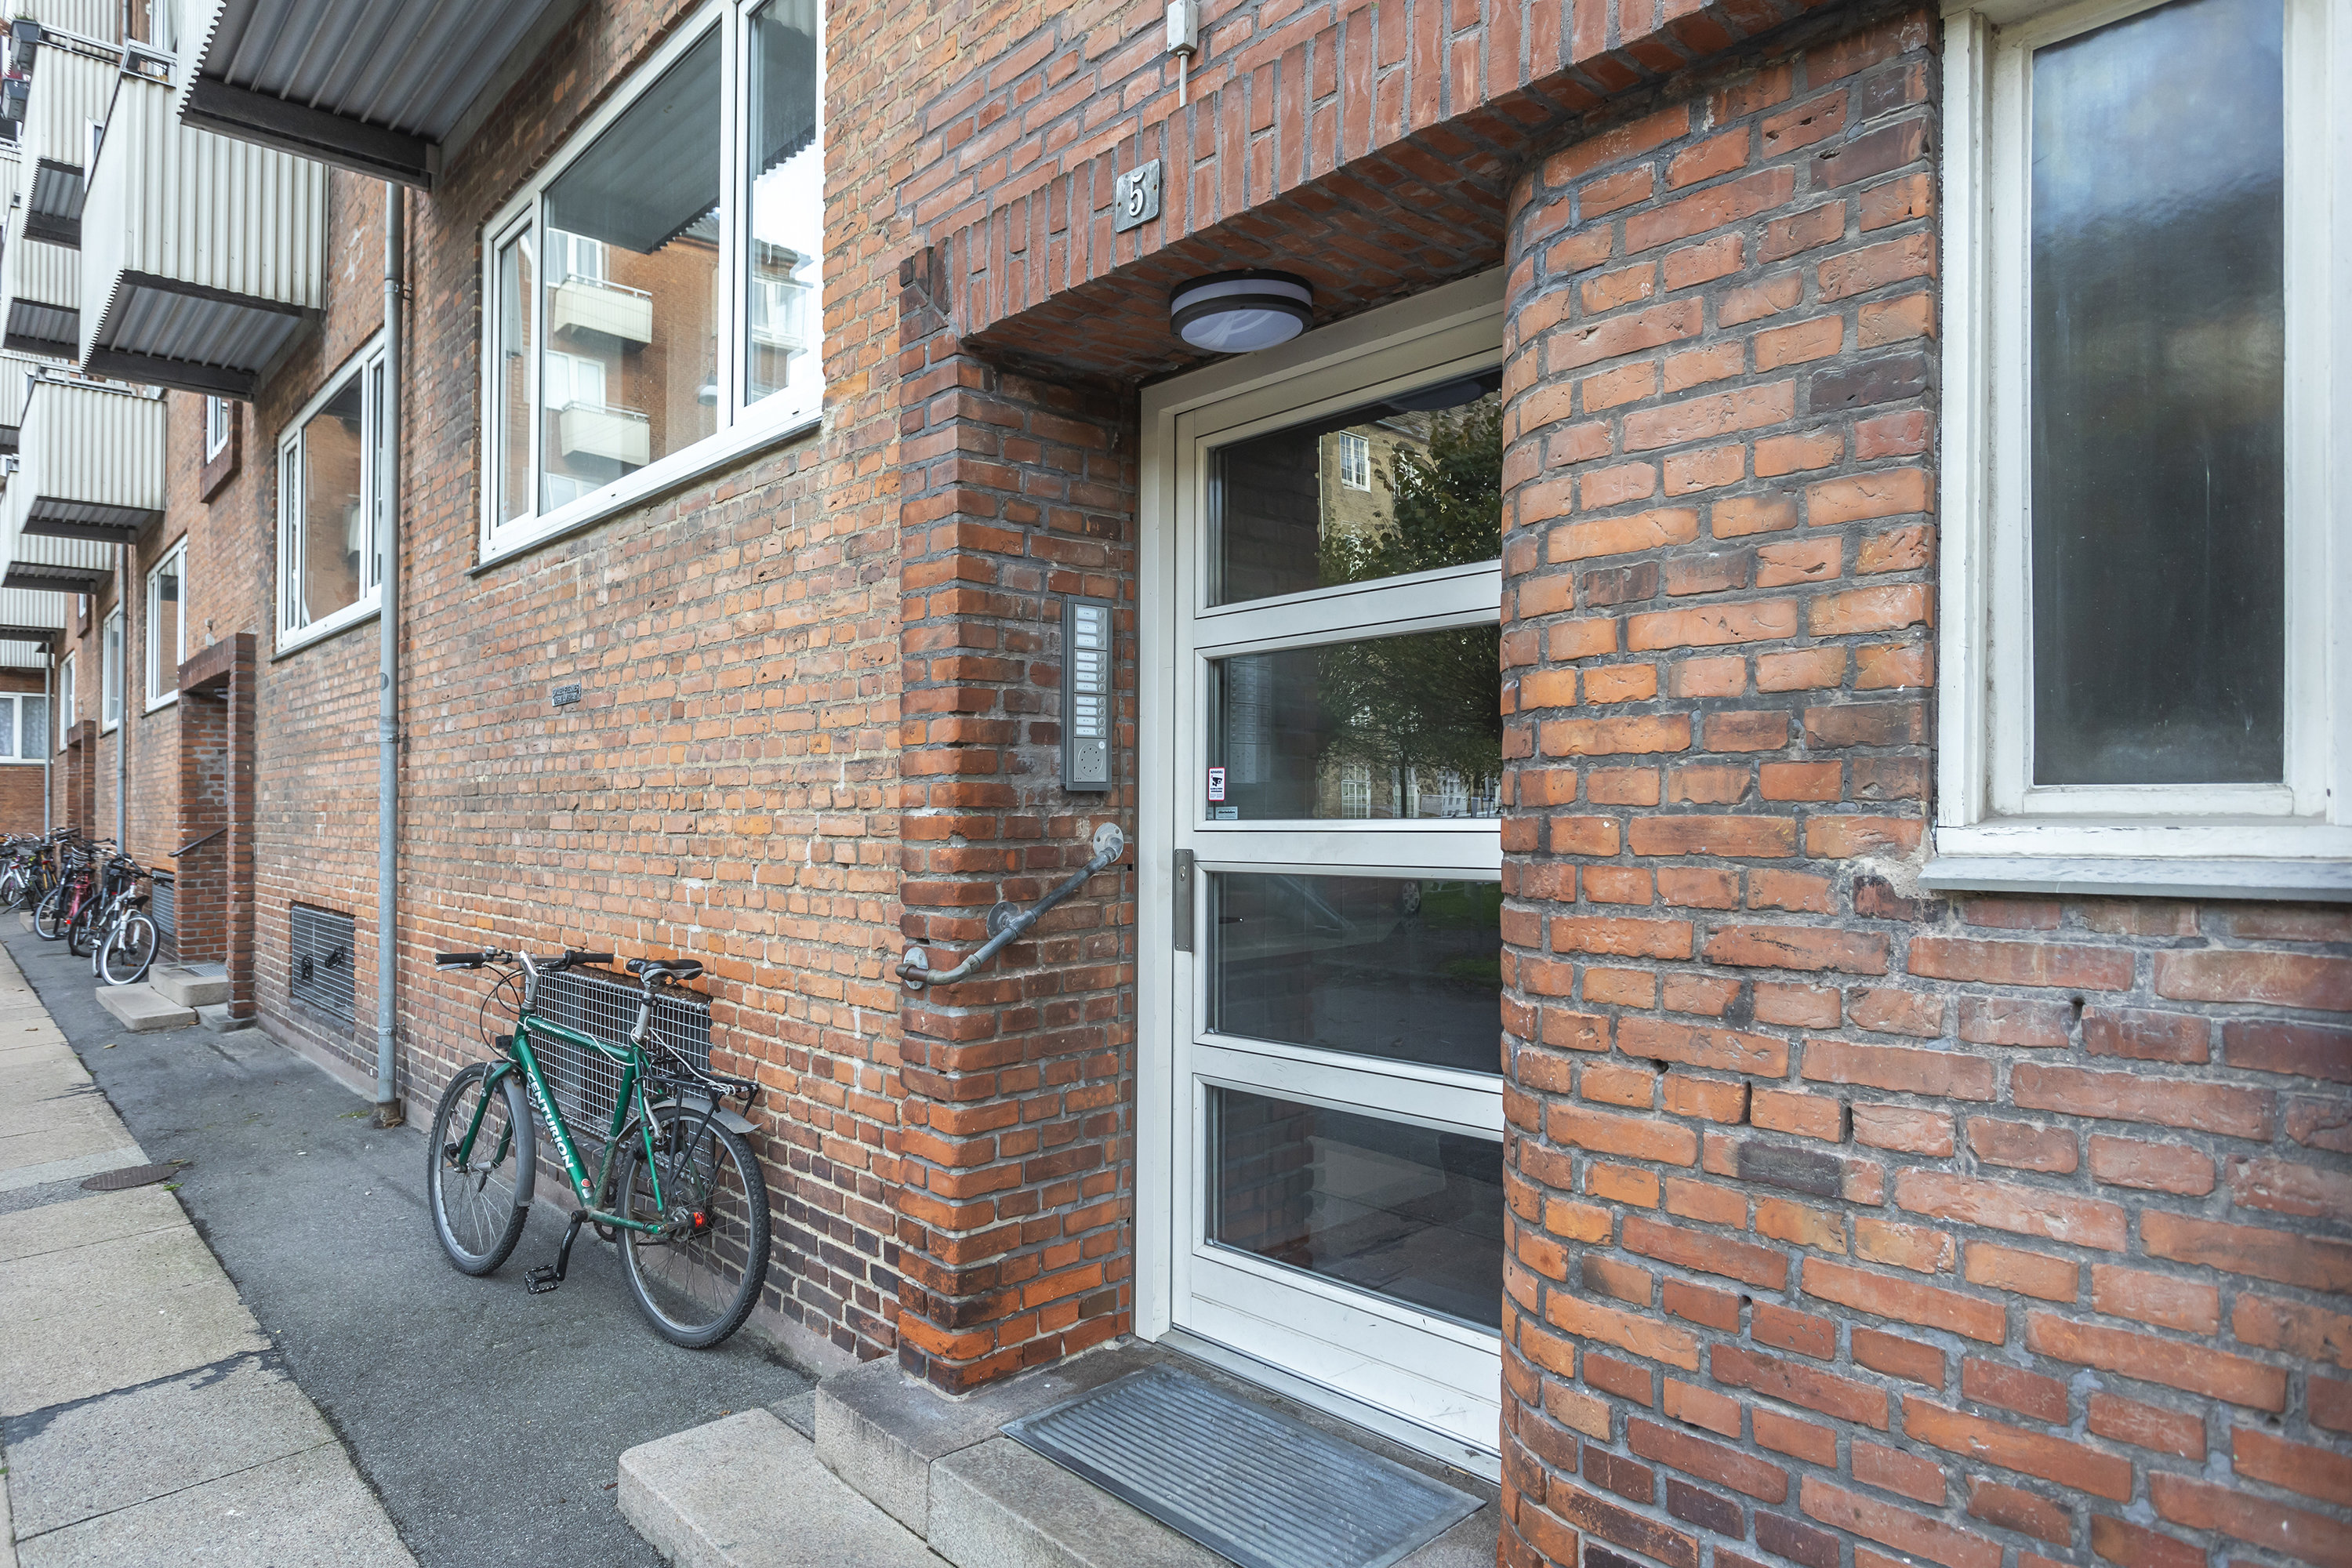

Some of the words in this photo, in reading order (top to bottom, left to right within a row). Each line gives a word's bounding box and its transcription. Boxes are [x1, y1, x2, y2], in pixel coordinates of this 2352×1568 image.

[1129, 172, 1145, 216] 5
[539, 1022, 553, 1031] CRAZY
[527, 1072, 574, 1169] CENTURION
